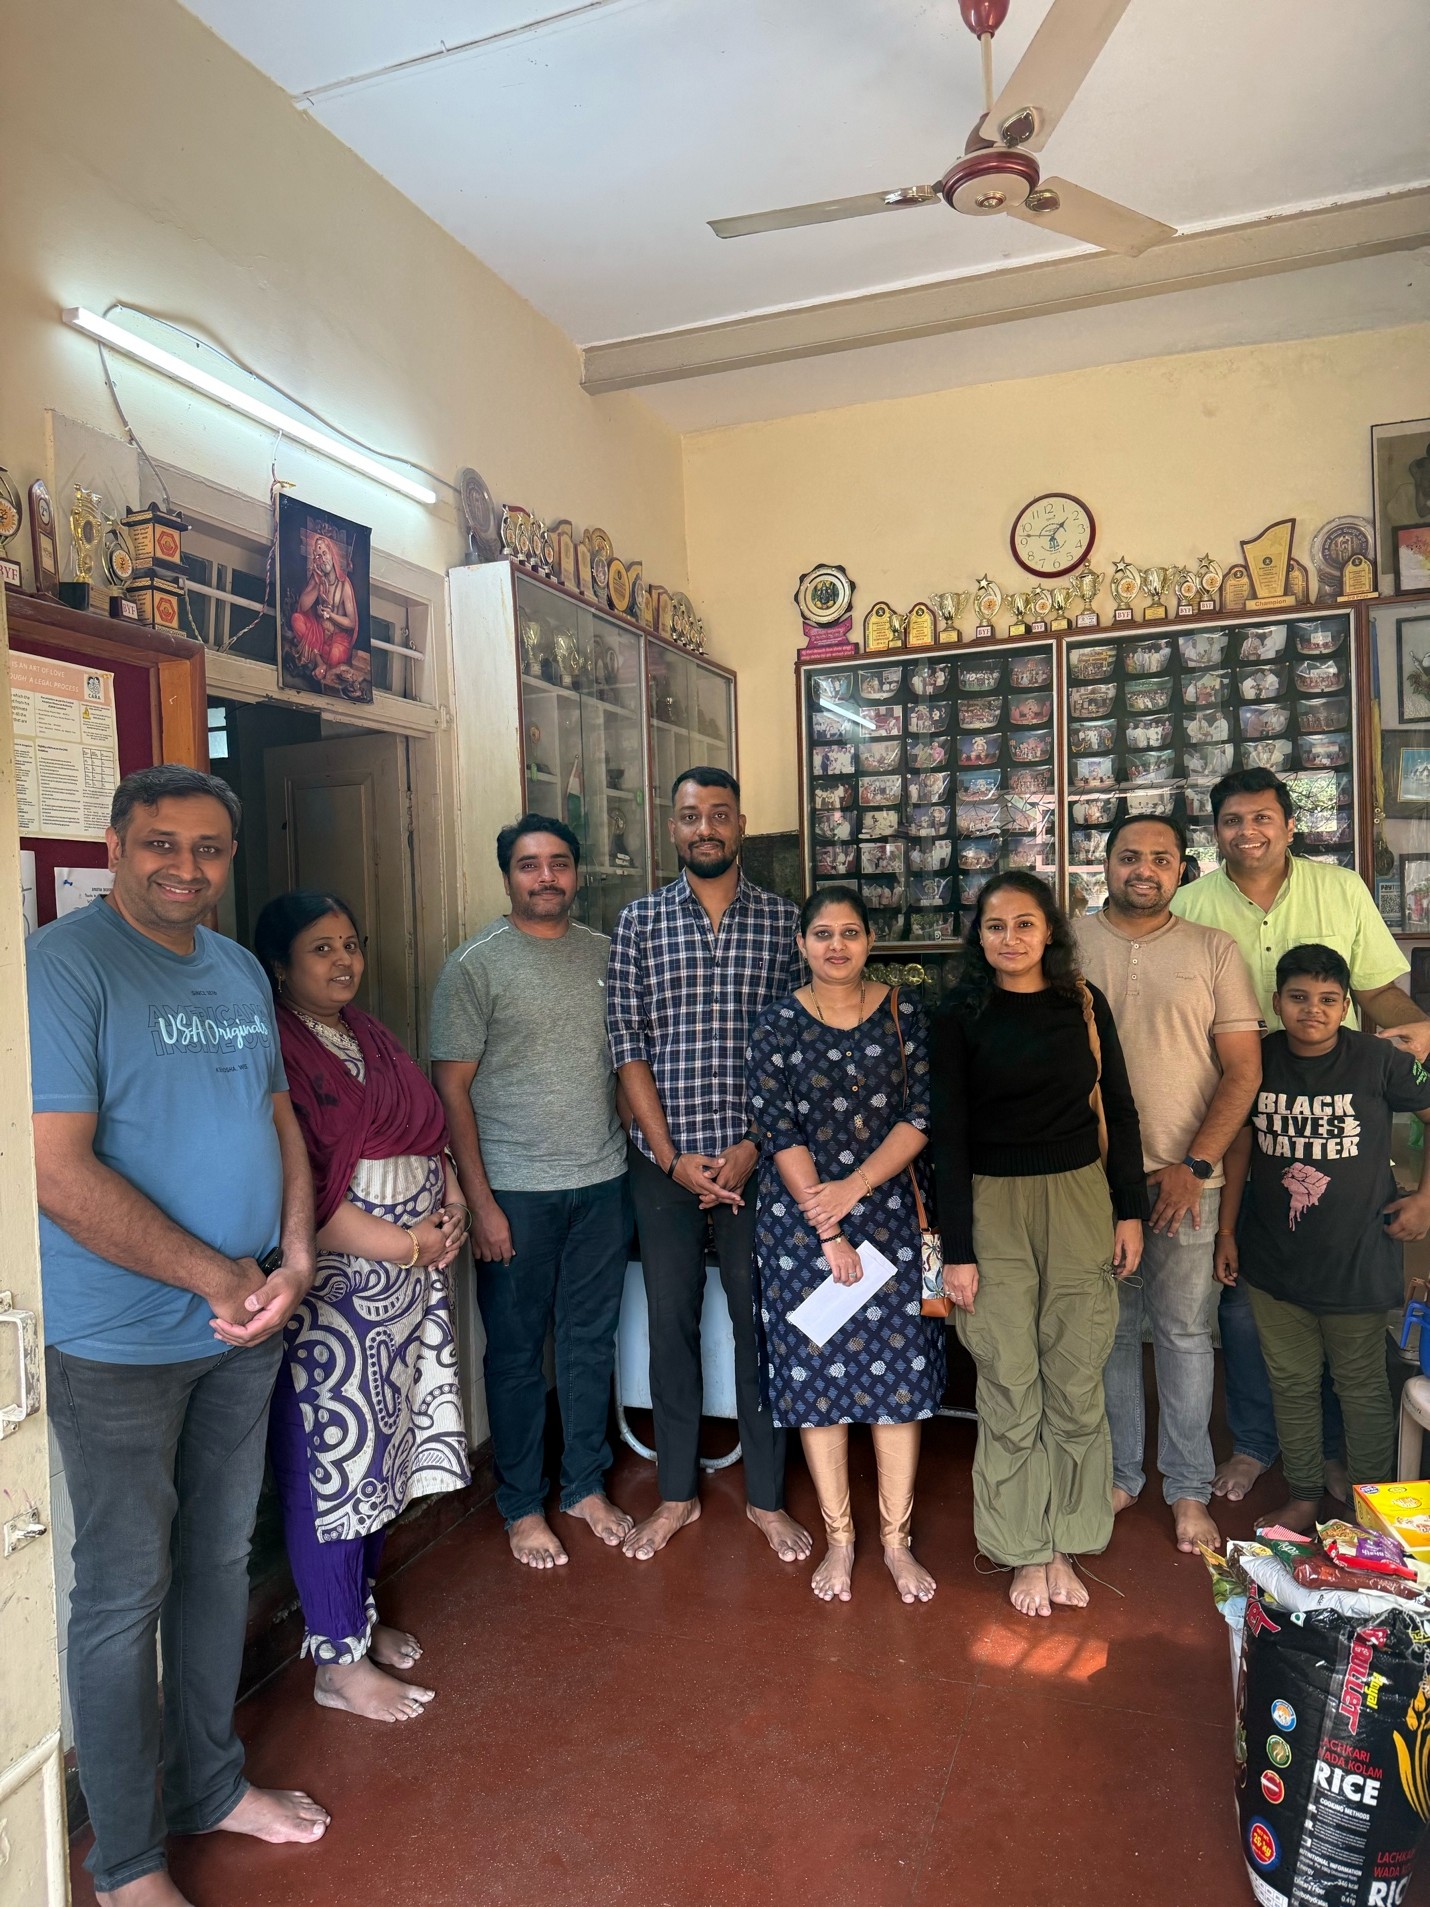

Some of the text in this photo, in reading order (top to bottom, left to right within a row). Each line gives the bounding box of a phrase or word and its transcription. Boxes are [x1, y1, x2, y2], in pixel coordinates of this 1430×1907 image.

[1044, 503, 1054, 514] 12
[1062, 504, 1065, 512] 1
[1032, 510, 1039, 520] 11
[1072, 510, 1079, 521] 2
[1022, 522, 1032, 533] 10
[1078, 524, 1086, 534] 3
[1021, 537, 1028, 548] 9
[1075, 539, 1082, 548] 4
[1028, 551, 1035, 561] 8
[1066, 552, 1074, 561] 5
[1039, 558, 1045, 568] 7
[1052, 559, 1060, 569] 6
[122, 603, 136, 615] BYF
[1254, 599, 1286, 607] Champion
[1117, 611, 1131, 619] BYF
[1180, 606, 1192, 614] BYF
[29, 665, 40, 673] ART
[50, 669, 65, 677] LOVE
[35, 679, 52, 687] LEGAL
[53, 682, 79, 692] PROCESS
[158, 1012, 268, 1049] USA Originals
[1258, 1092, 1355, 1115] BLACK
[1266, 1115, 1346, 1137] LIVES
[1258, 1132, 1360, 1160] MATTER
[1364, 1672, 1384, 1709] Royal
[1322, 1737, 1370, 1762] ACHKARI
[1347, 1761, 1383, 1779] KOLAM
[1313, 1760, 1381, 1806] RICE
[1320, 1798, 1370, 1820] COOKING METHODS
[1330, 1862, 1362, 1876] INFORMATION
[1374, 1866, 1400, 1878] WADA
[1297, 1861, 1314, 1875] Energy
[1348, 1882, 1359, 1890] kcal
[1367, 1872, 1412, 1907] RIC
